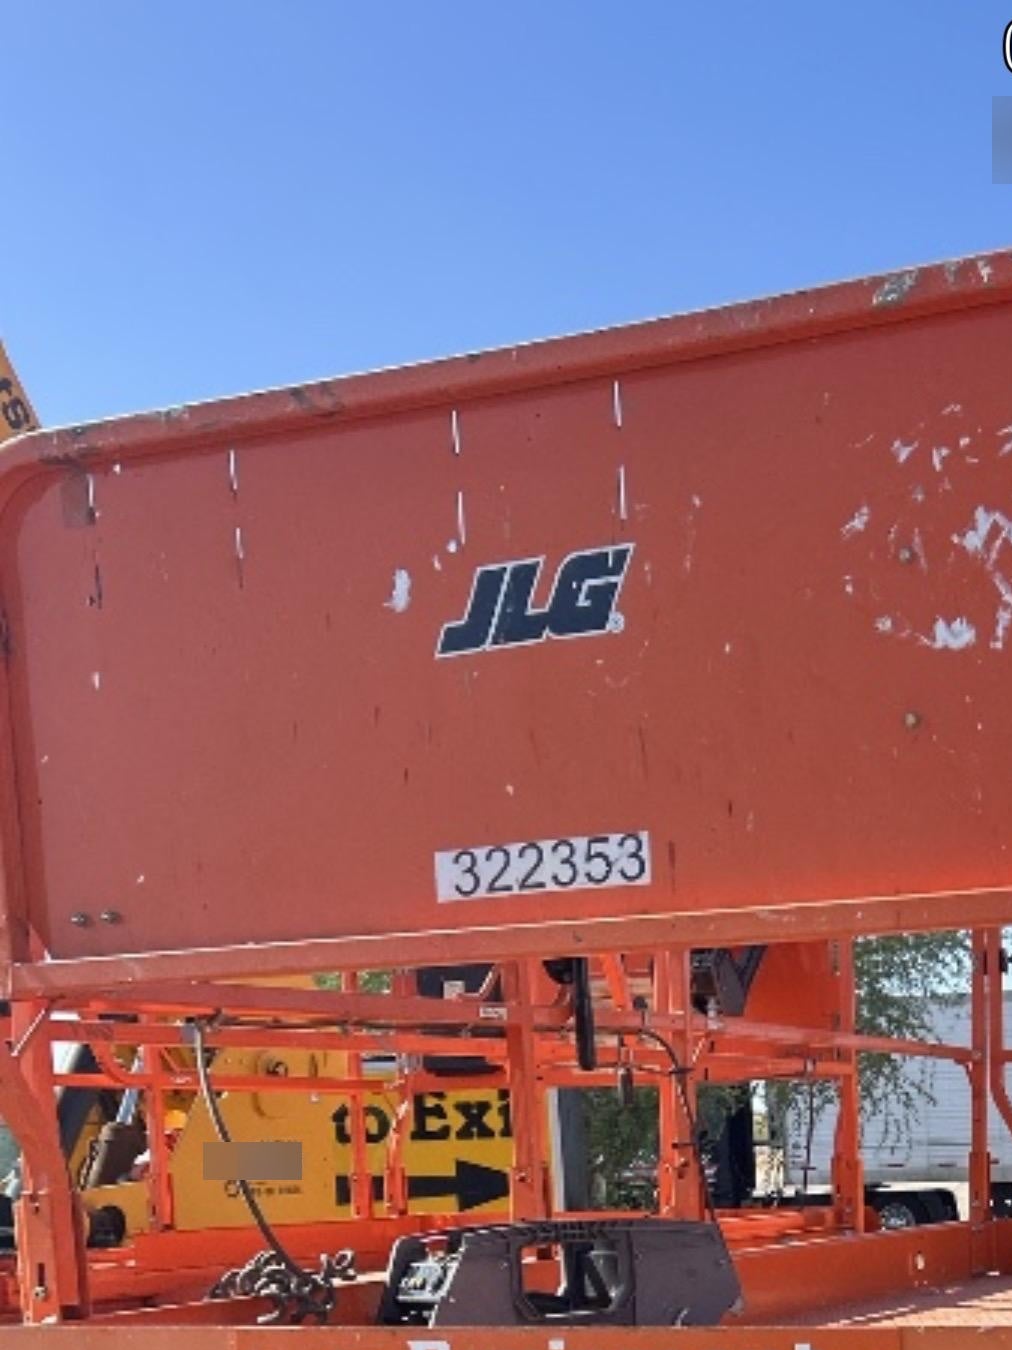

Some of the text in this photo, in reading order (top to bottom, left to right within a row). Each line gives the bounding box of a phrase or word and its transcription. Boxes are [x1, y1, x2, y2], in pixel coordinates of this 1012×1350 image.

[436, 543, 636, 661] JLG
[454, 833, 649, 898] 322353
[331, 1089, 513, 1144] to Exi
